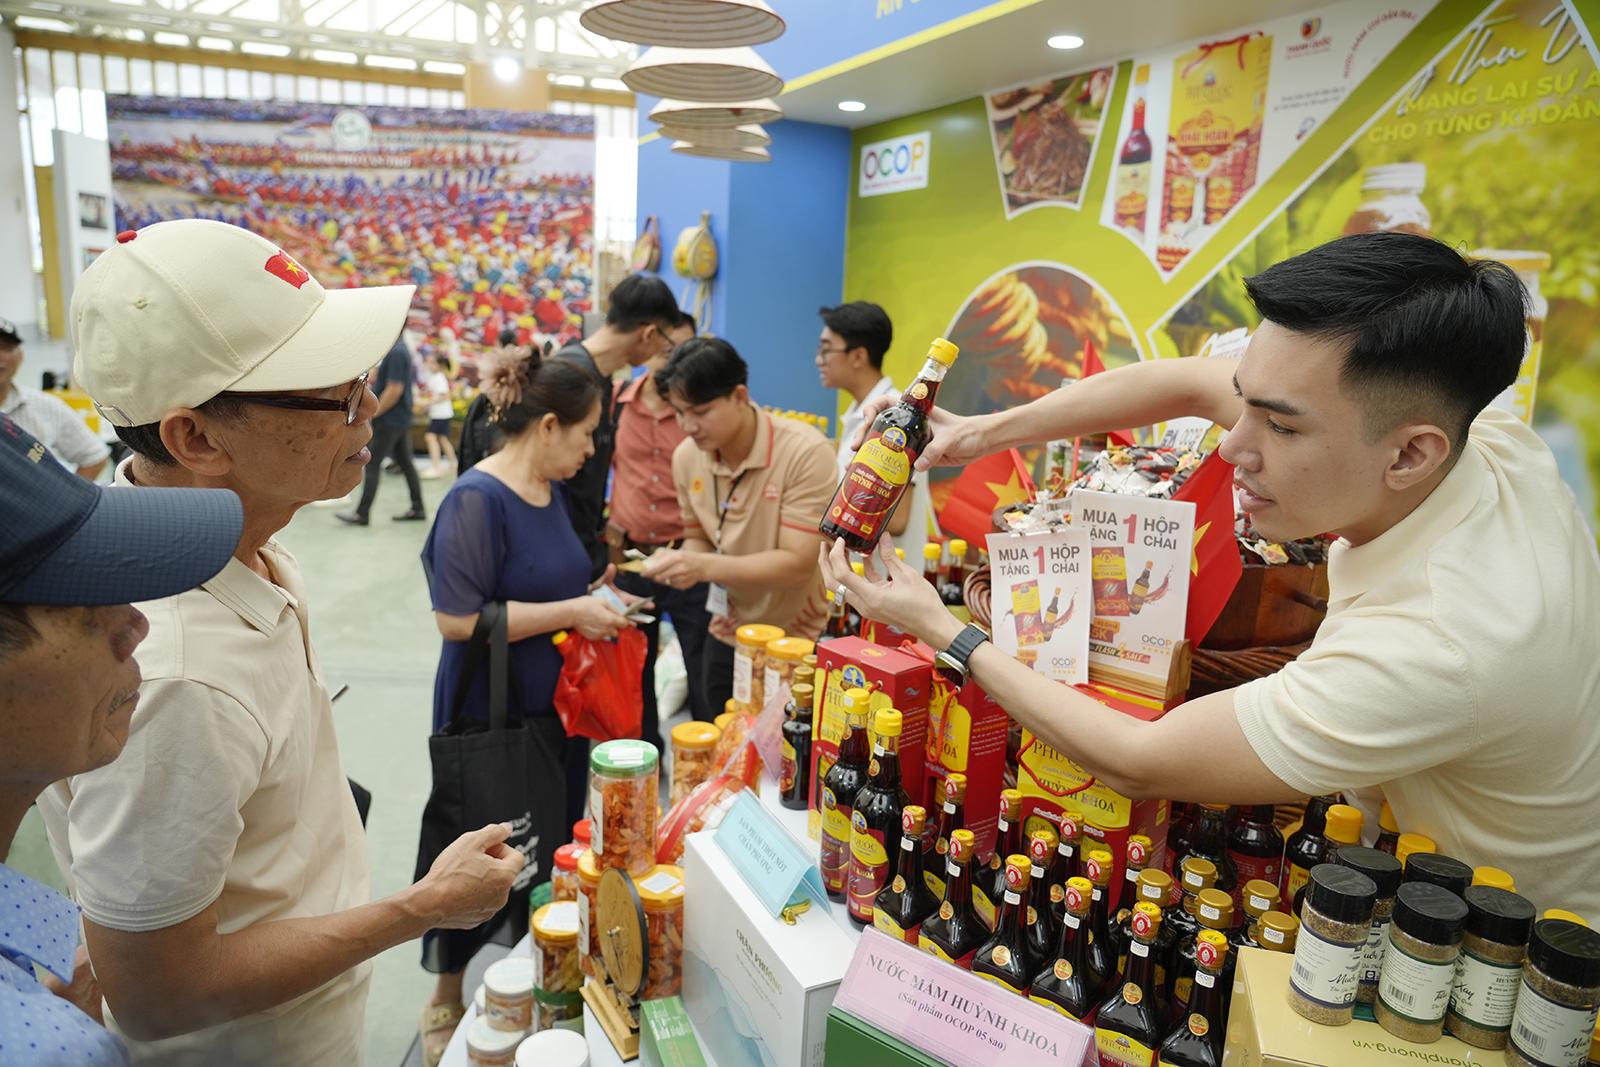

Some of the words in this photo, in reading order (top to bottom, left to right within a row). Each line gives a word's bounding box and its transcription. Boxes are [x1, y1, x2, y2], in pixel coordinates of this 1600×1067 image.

[1403, 87, 1478, 113] MANG
[1485, 79, 1529, 105] LẠI
[1535, 68, 1580, 98] SỰ
[1367, 121, 1418, 143] CHO
[1422, 112, 1493, 136] TỪNG
[863, 140, 924, 179] OCOP
[1082, 508, 1118, 526] MUA
[1123, 513, 1138, 545] 1
[1143, 515, 1180, 536] HỘP
[1083, 525, 1118, 542] ẶNG
[1143, 534, 1177, 550] CHAI
[999, 549, 1029, 561] MUA
[1033, 546, 1045, 574] 1
[1050, 543, 1080, 563] HỘP
[1000, 562, 1030, 578] TẶNG
[1051, 562, 1080, 574] CHAI
[1080, 792, 1116, 814] KHOA
[866, 954, 910, 983] NƯỚC
[910, 972, 948, 1002] MẮM
[950, 994, 1008, 1032] HUỲNH
[1009, 1022, 1059, 1057] KHOA
[1453, 981, 1475, 1001] Xay
[944, 1013, 975, 1034] OCOP
[975, 1029, 988, 1041] 05
[988, 1036, 1007, 1052] sao)
